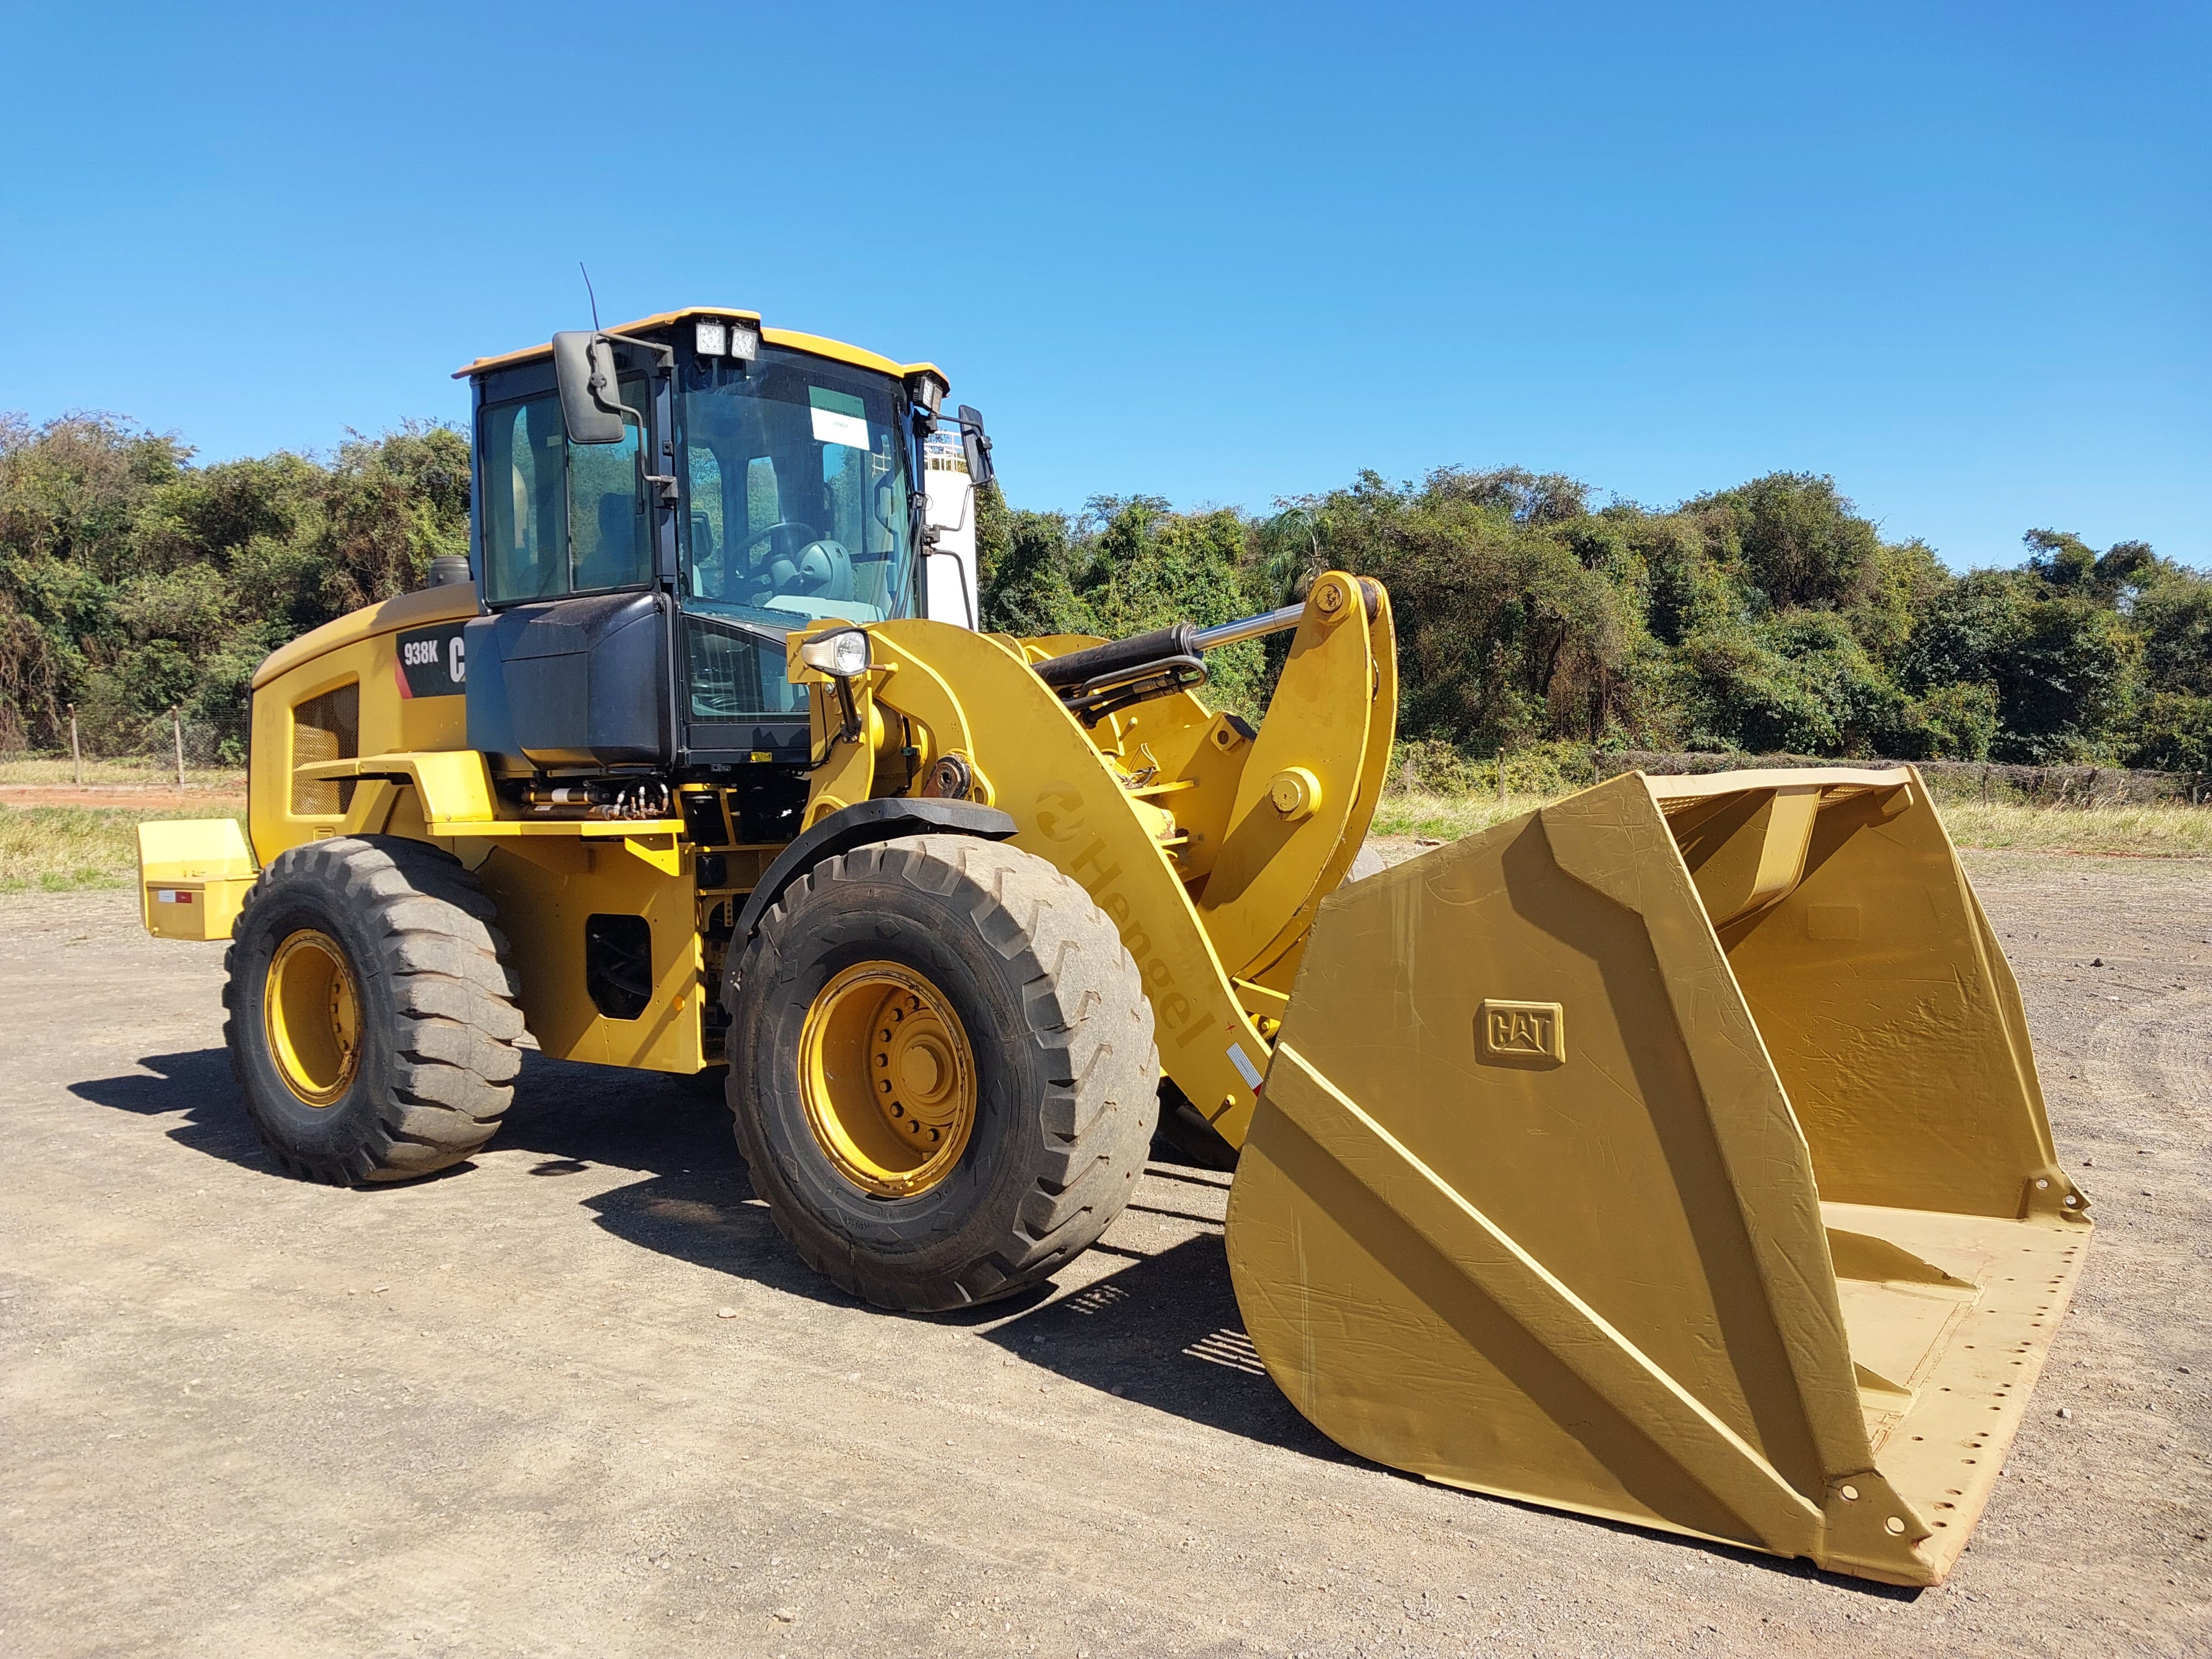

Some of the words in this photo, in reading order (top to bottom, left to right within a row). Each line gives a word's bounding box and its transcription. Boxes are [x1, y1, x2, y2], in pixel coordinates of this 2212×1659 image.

[404, 640, 438, 665] 938K
[1071, 839, 1215, 1048] Hengel
[1488, 1009, 1552, 1054] CAT
